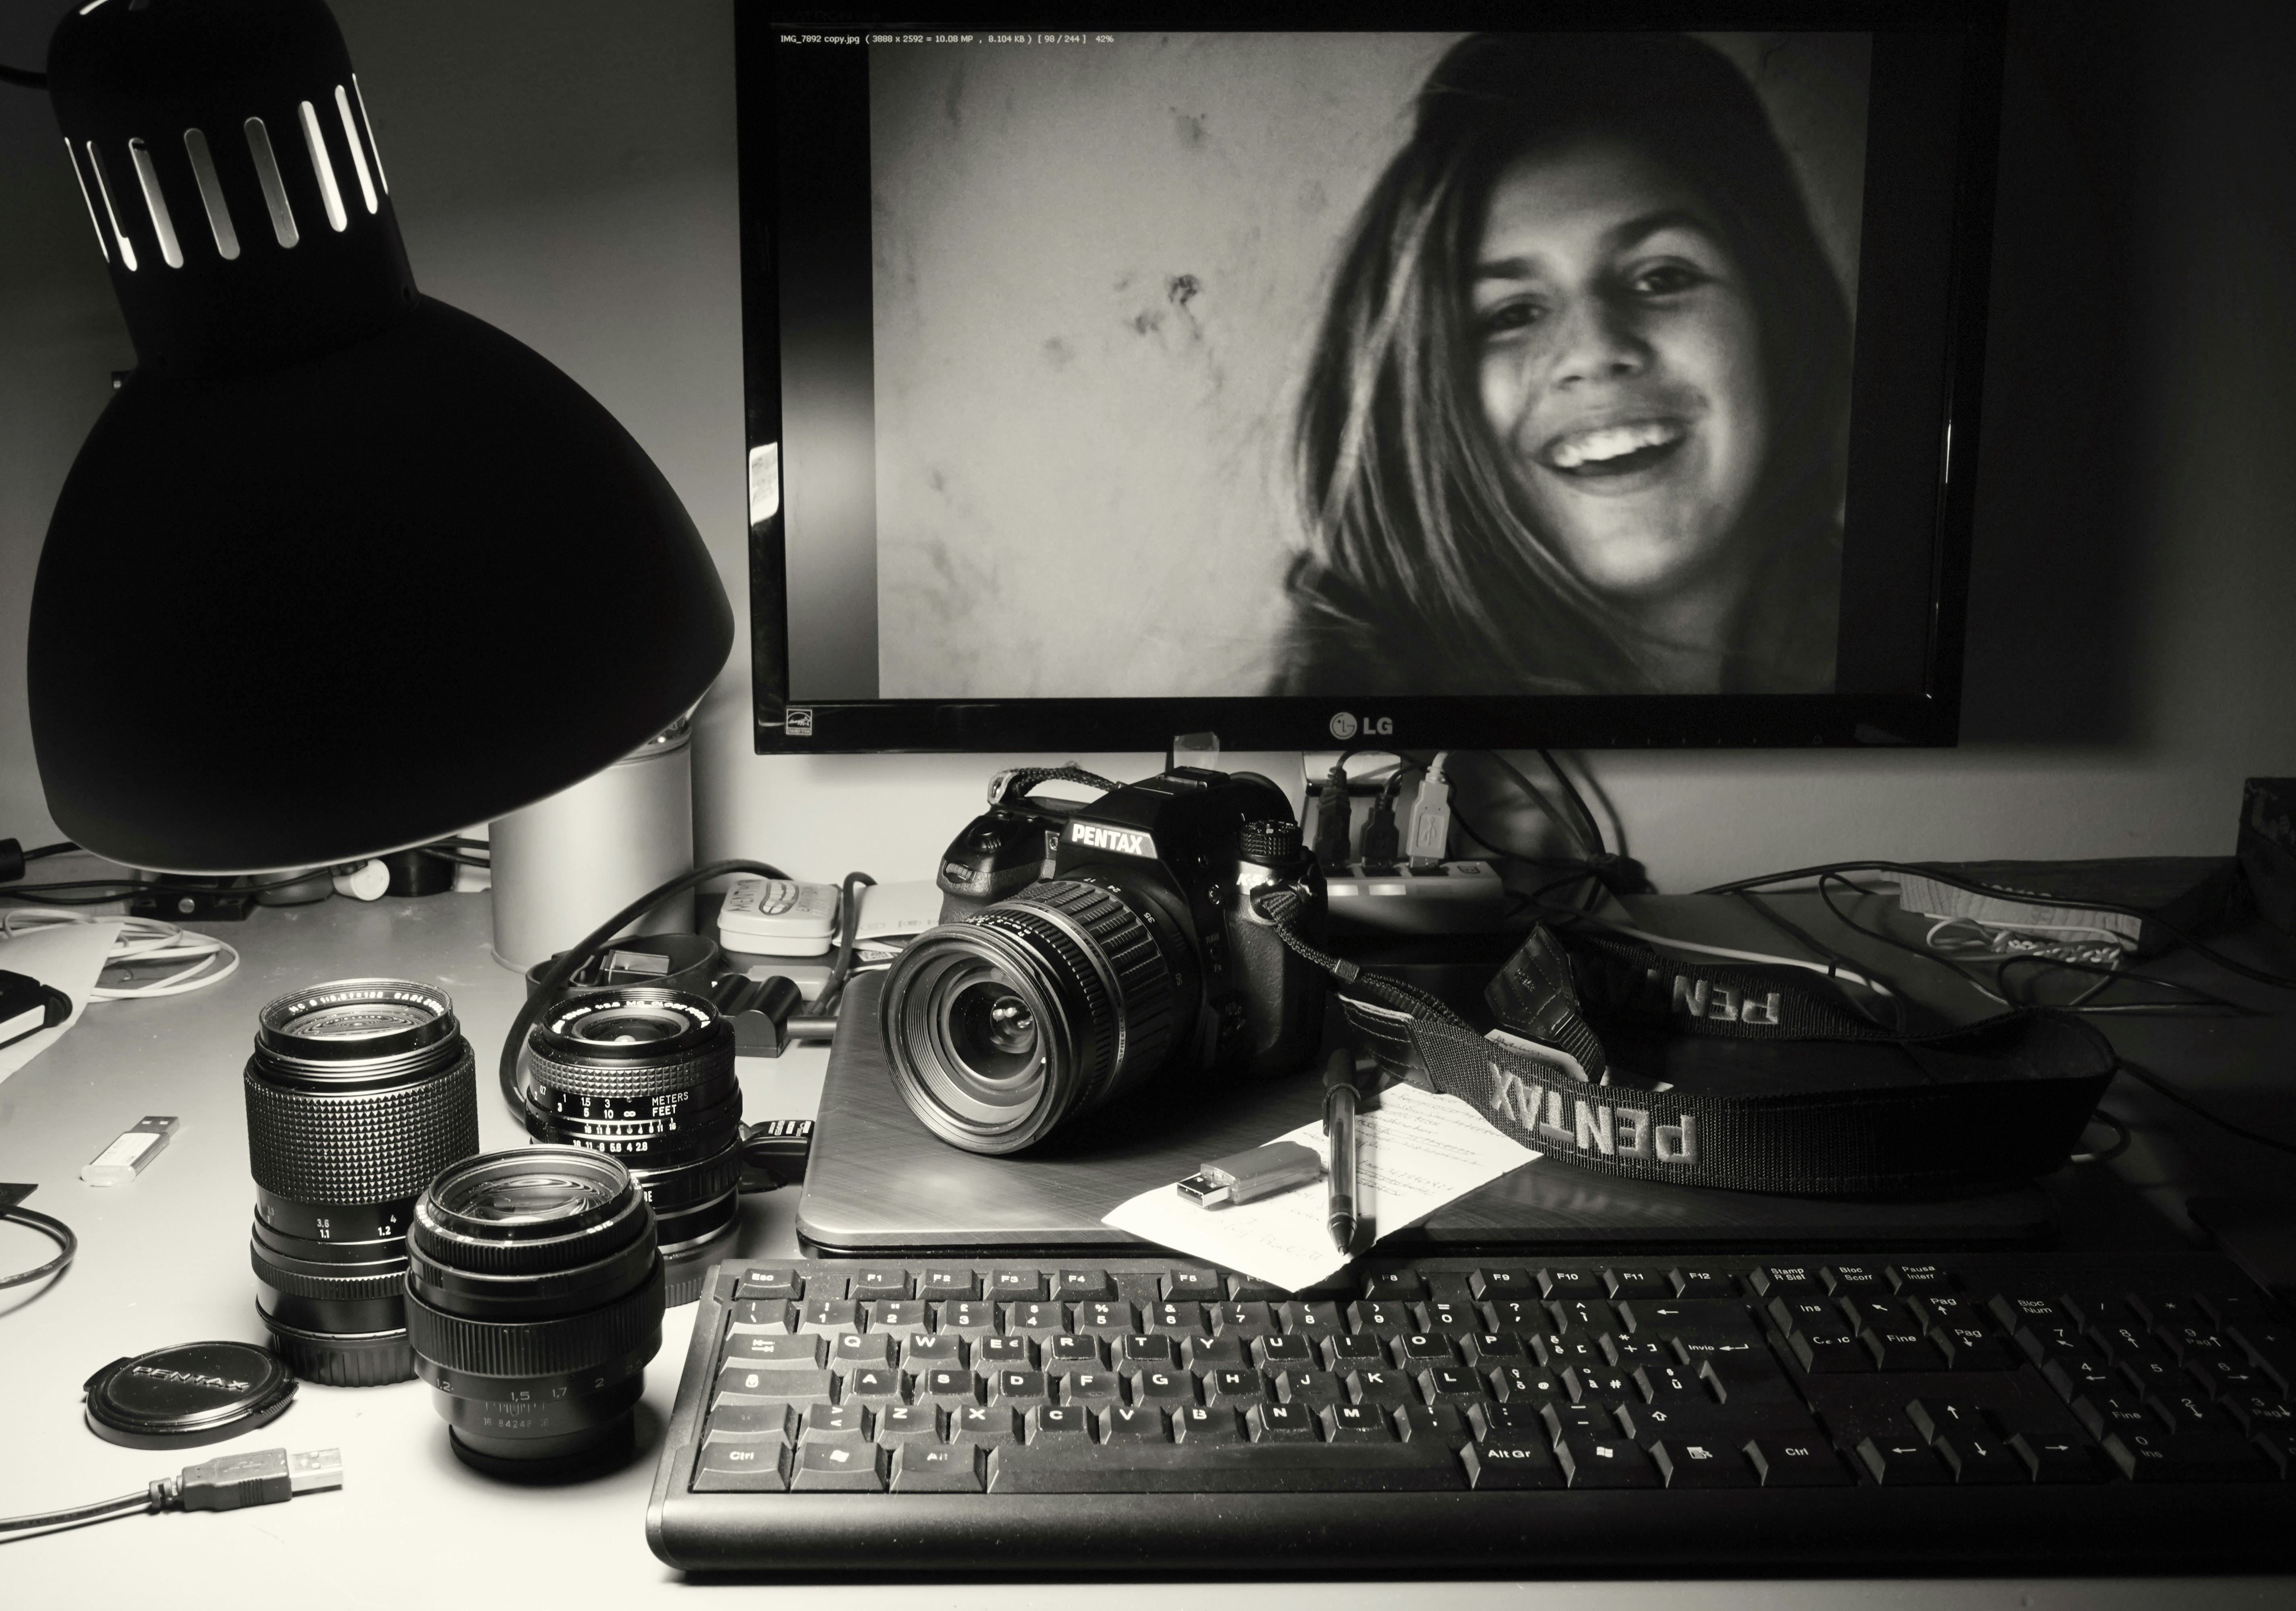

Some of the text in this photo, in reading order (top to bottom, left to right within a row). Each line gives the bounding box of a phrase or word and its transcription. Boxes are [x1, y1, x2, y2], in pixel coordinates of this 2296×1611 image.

[781, 35, 821, 43] IMG_7892
[824, 35, 860, 44] copy.jpg
[1364, 717, 1393, 735] LG
[1072, 824, 1142, 855] PENTAX
[1143, 912, 1155, 923] 35
[1205, 932, 1220, 944] RAW
[1175, 973, 1183, 986] 50
[581, 1097, 591, 1107] 1.5
[605, 1099, 610, 1108] 3
[652, 1091, 689, 1106] METERS
[557, 1102, 562, 1112] 3
[584, 1108, 590, 1117] 5
[604, 1109, 614, 1119] 10
[653, 1104, 677, 1117] FEET
[1489, 1059, 1699, 1166] PENTAX
[584, 1125, 592, 1134] 16
[599, 1142, 605, 1151] 8
[610, 1142, 622, 1153] 5.6
[626, 1143, 633, 1152] 4
[635, 1141, 648, 1151] 2.8
[317, 1215, 397, 1228] 3.6 4
[319, 1226, 391, 1238] 1.1 1.2
[867, 1274, 882, 1282] F1
[933, 1273, 951, 1282] F2
[1510, 1303, 1519, 1311] ?
[1930, 1298, 1957, 1308] Pag
[1095, 1304, 1109, 1313] %
[1165, 1304, 1176, 1313] &
[819, 1313, 826, 1323] 1
[887, 1314, 897, 1323] 2
[959, 1315, 969, 1325] 3
[1027, 1317, 1037, 1326] 4
[1097, 1315, 1107, 1324] 5
[1166, 1315, 1176, 1324] 6
[1236, 1315, 1245, 1323] 7
[1305, 1315, 1315, 1324] 8
[1374, 1315, 1384, 1323] 9
[1954, 1329, 1983, 1337] Pag
[2054, 1329, 2063, 1337] 7
[2119, 1329, 2132, 1339] 8
[844, 1336, 861, 1348] Q
[915, 1336, 936, 1347] W
[1060, 1338, 1074, 1346] R
[1135, 1337, 1147, 1346] T
[1270, 1338, 1283, 1347] U
[1346, 1338, 1351, 1346] I
[1411, 1336, 1426, 1345] O
[1485, 1336, 1497, 1344] P
[1886, 1334, 1917, 1342] Fine
[990, 1339, 1002, 1348] E
[1200, 1338, 1214, 1349] Y
[2081, 1363, 2092, 1371] 4
[2151, 1364, 2163, 1372] 5
[133, 1366, 249, 1392] PENTAX
[862, 1374, 877, 1384] A
[937, 1374, 950, 1383] S
[1010, 1375, 1024, 1385] D
[1080, 1375, 1093, 1386] F
[1152, 1374, 1168, 1385] G
[1226, 1374, 1239, 1383] H
[1301, 1374, 1310, 1385] J
[1368, 1373, 1383, 1383] K
[1444, 1373, 1457, 1381] L
[595, 1378, 604, 1389] 2
[893, 1408, 908, 1418] Z
[969, 1408, 985, 1420] X
[1049, 1410, 1063, 1420] C
[1119, 1408, 1134, 1420] V
[1192, 1409, 1207, 1420] B
[1273, 1408, 1287, 1417] N
[1343, 1408, 1360, 1417] M
[729, 1452, 754, 1461] Ctrl
[2140, 1450, 2163, 1458] Ins
